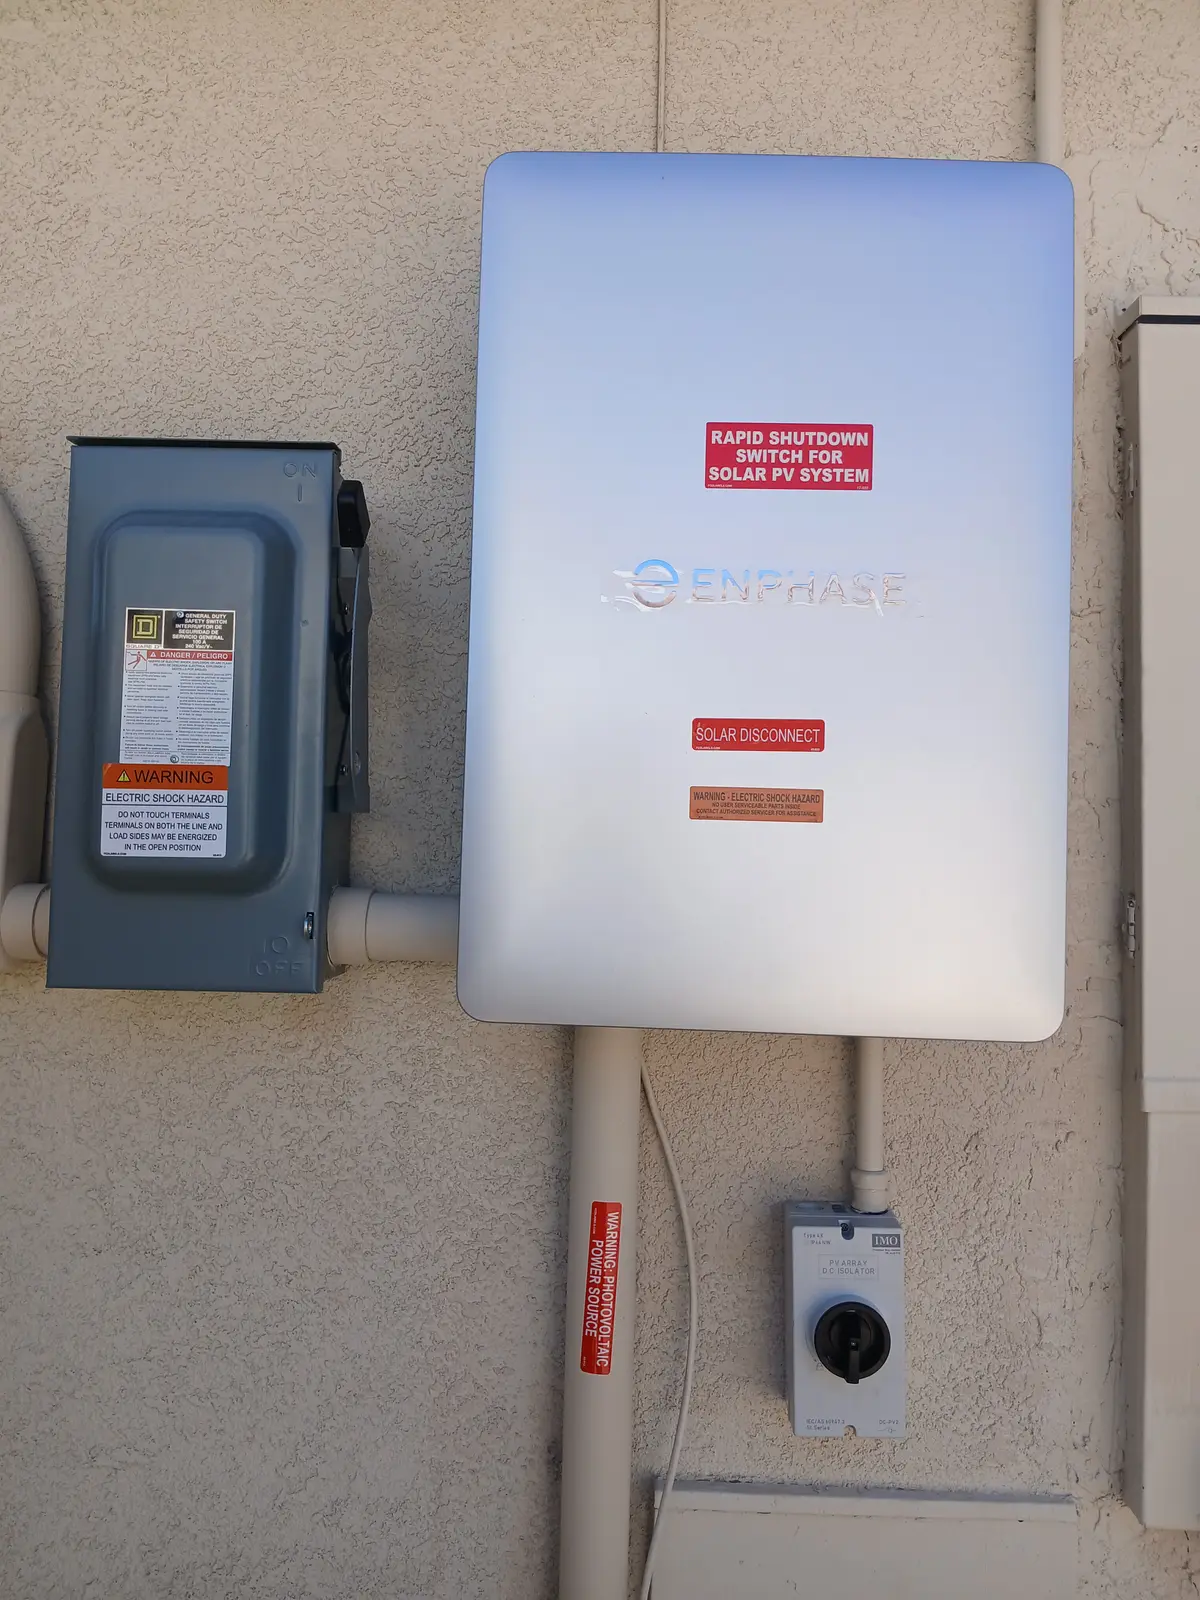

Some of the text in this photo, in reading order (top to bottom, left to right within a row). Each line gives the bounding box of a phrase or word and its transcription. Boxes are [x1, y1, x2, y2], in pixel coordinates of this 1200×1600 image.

[711, 430, 868, 446] RAPID SHUTDOWN
[736, 449, 842, 464] SWITCH FOR
[708, 467, 868, 482] SOLAR PV SYSTEM
[692, 568, 906, 605] ENPHASE
[696, 728, 820, 743] SOLAR DISCONNECT
[134, 770, 214, 784] WARNING
[106, 793, 224, 804] ELECTRIC SHOCK HAZARD
[694, 792, 726, 801] WARNING
[732, 792, 764, 802] ELECTRIC
[767, 793, 790, 803] SHOCK
[792, 794, 820, 804] HAZARD
[875, 1236, 898, 1245] IMO
[585, 1240, 604, 1338] POWER SOURCE
[596, 1212, 619, 1367] WARNING: PHOTOVOLTAIC
